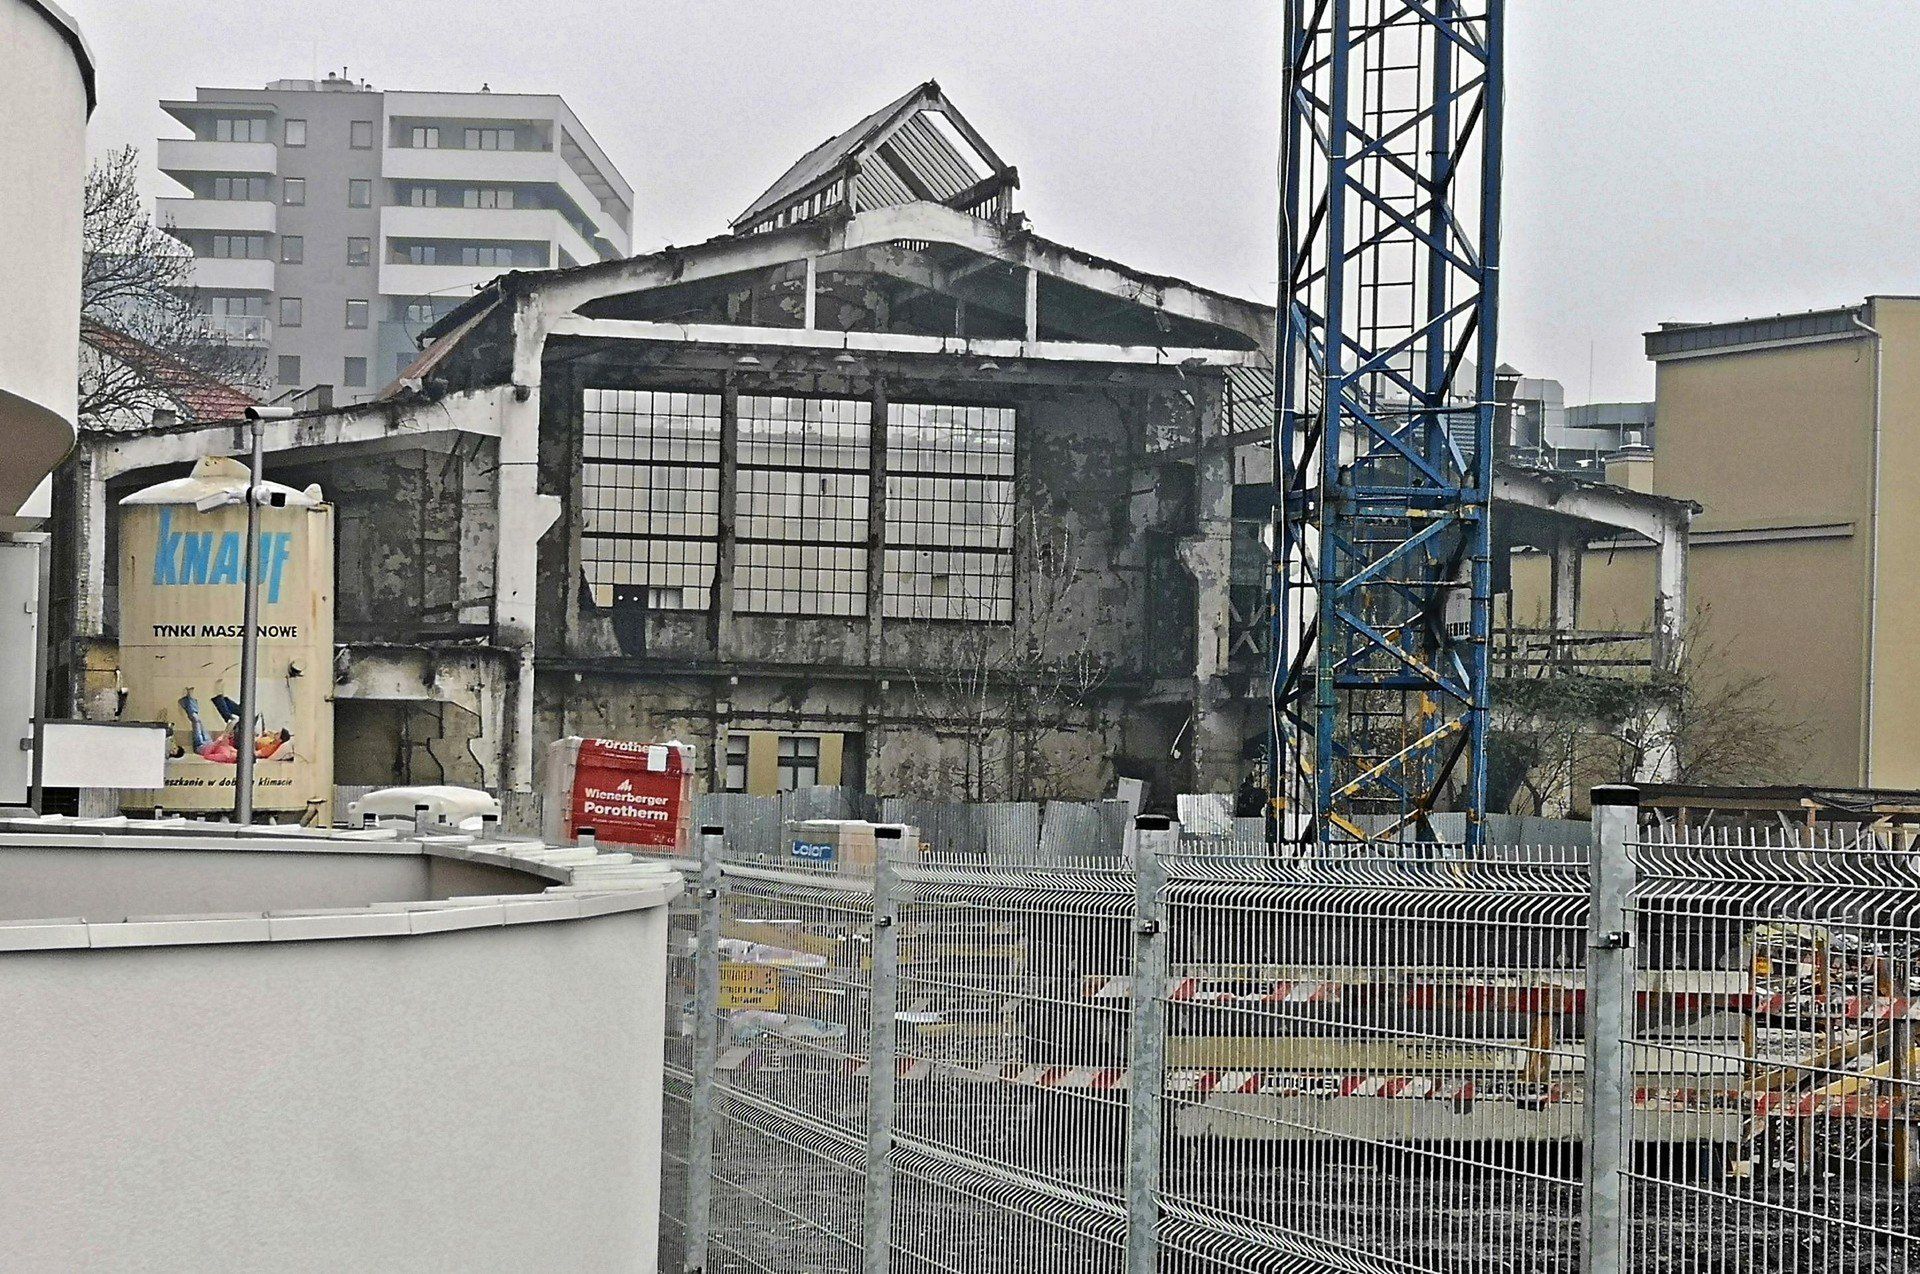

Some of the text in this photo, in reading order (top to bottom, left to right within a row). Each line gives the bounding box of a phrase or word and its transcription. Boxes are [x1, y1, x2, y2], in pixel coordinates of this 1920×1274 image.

[153, 507, 292, 604] KNAUF
[153, 625, 298, 638] TYNKI MASZNOWE
[595, 739, 650, 754] Porothe
[585, 788, 669, 806] Wienerberger
[584, 802, 669, 821] Porotherm
